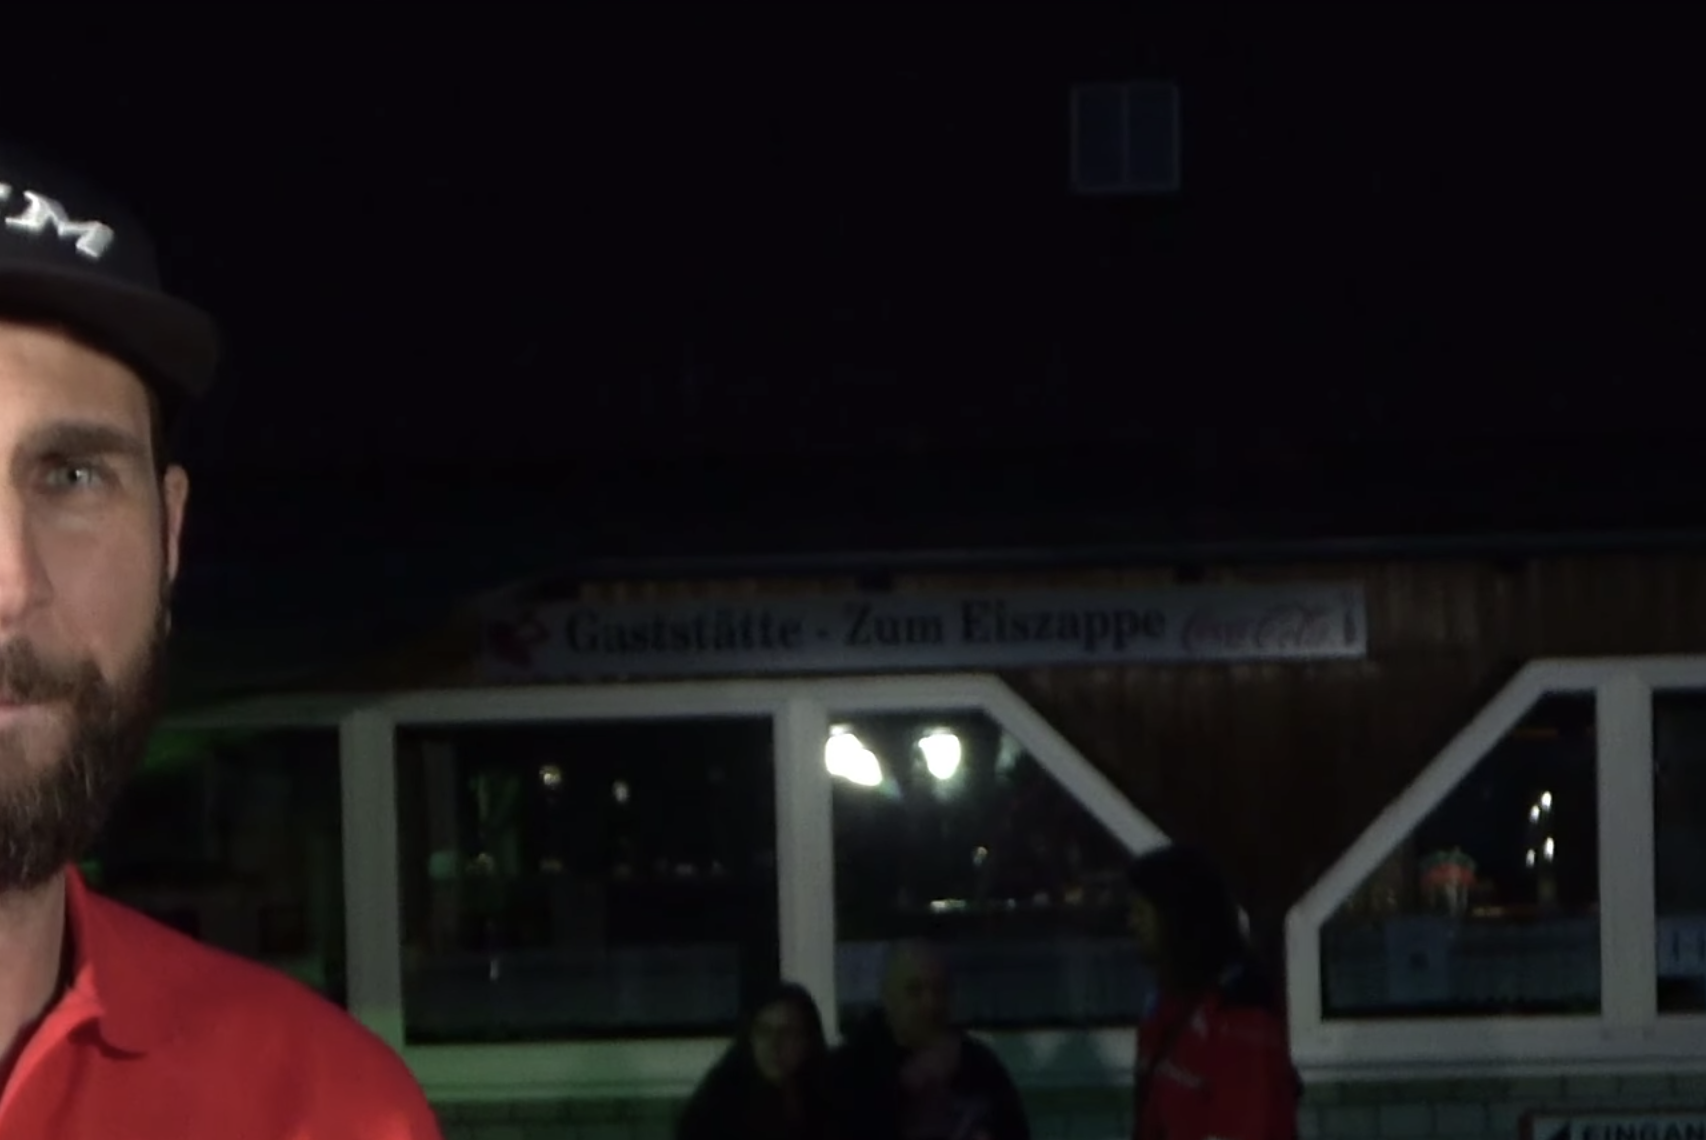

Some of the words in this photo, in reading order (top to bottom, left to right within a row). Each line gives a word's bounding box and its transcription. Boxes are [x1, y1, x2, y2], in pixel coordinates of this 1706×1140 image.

[565, 608, 803, 651] Gaststätte
[845, 602, 943, 646] Zum
[960, 598, 1166, 650] Eiszappe
